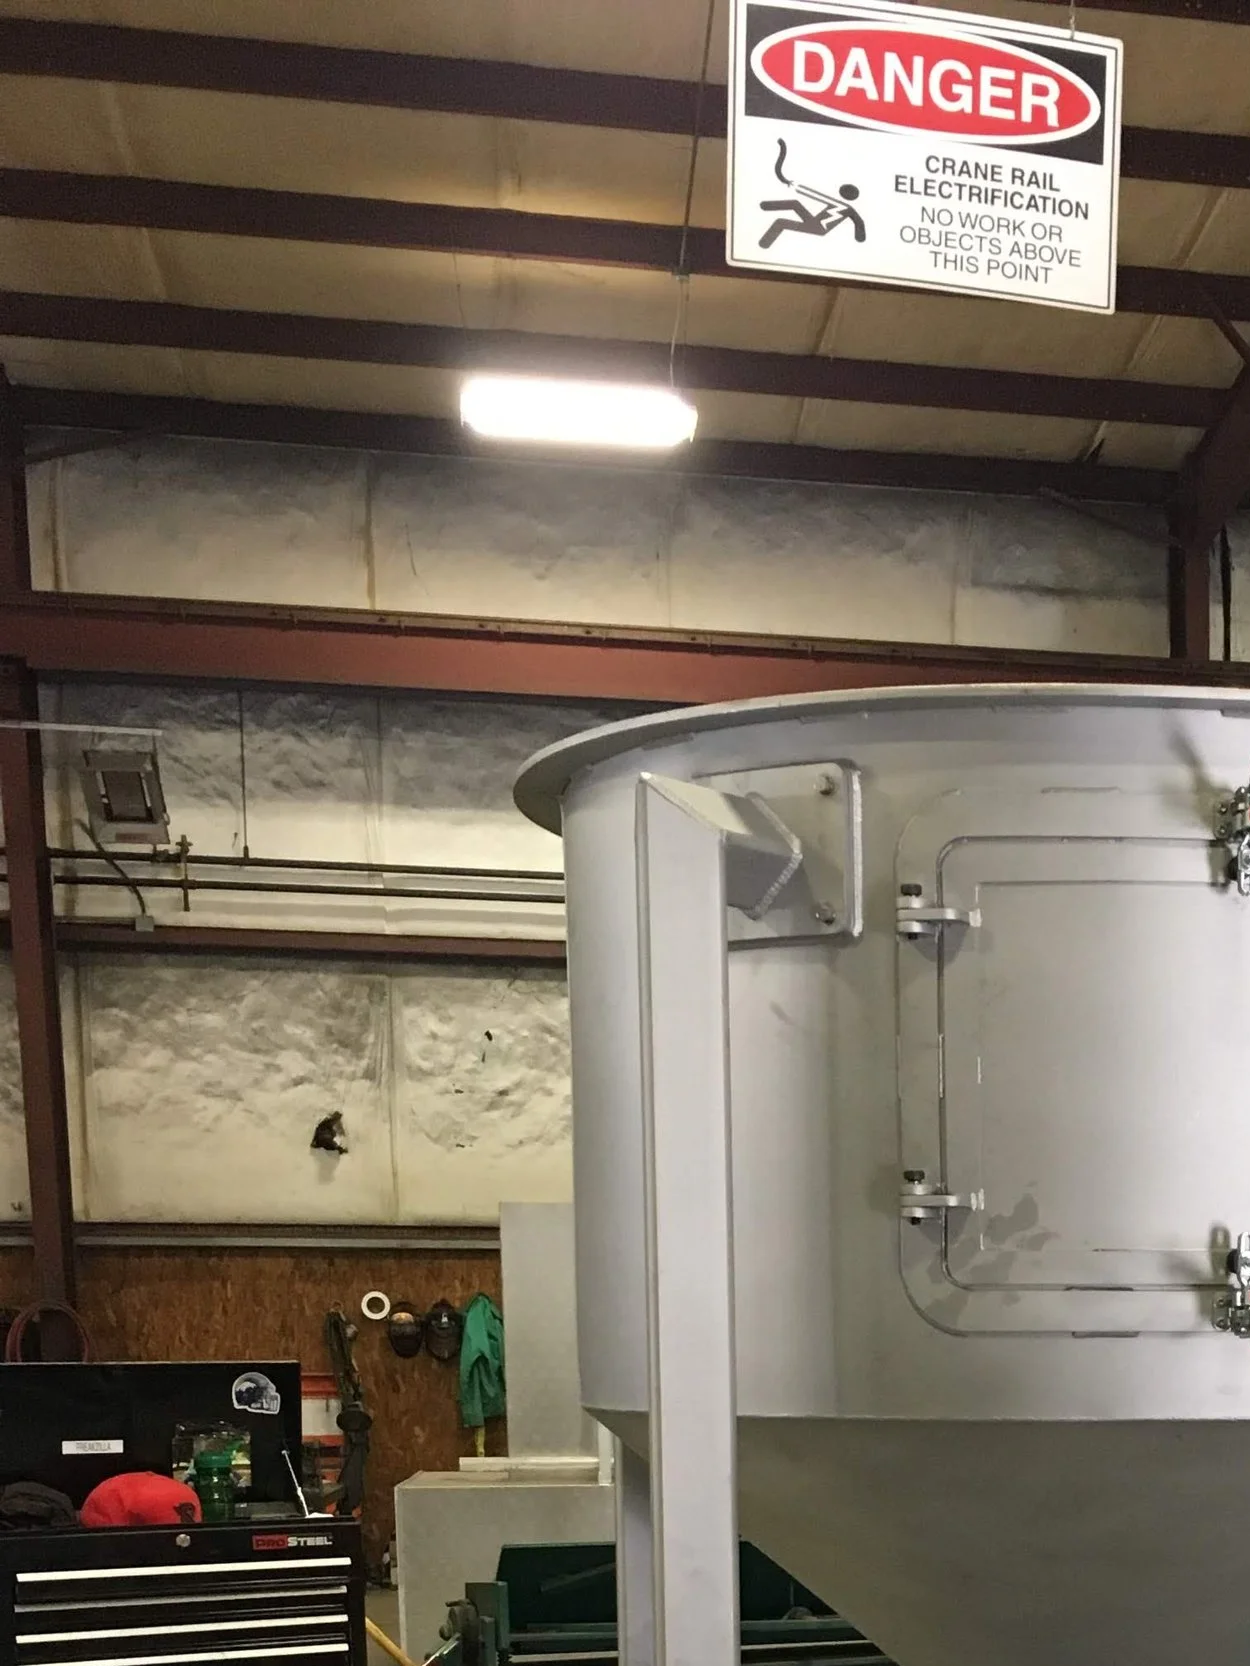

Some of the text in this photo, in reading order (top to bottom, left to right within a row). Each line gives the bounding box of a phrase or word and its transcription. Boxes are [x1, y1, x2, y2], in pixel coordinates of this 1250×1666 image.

[792, 39, 1061, 128] DANGER
[924, 155, 1061, 193] CRANE RAIL
[894, 174, 1090, 221] ELECTRIFICATION
[920, 205, 1063, 243] NO WORK OR
[899, 225, 1082, 268] OBJECTS ABOVE
[929, 250, 1053, 285] THIS POINT
